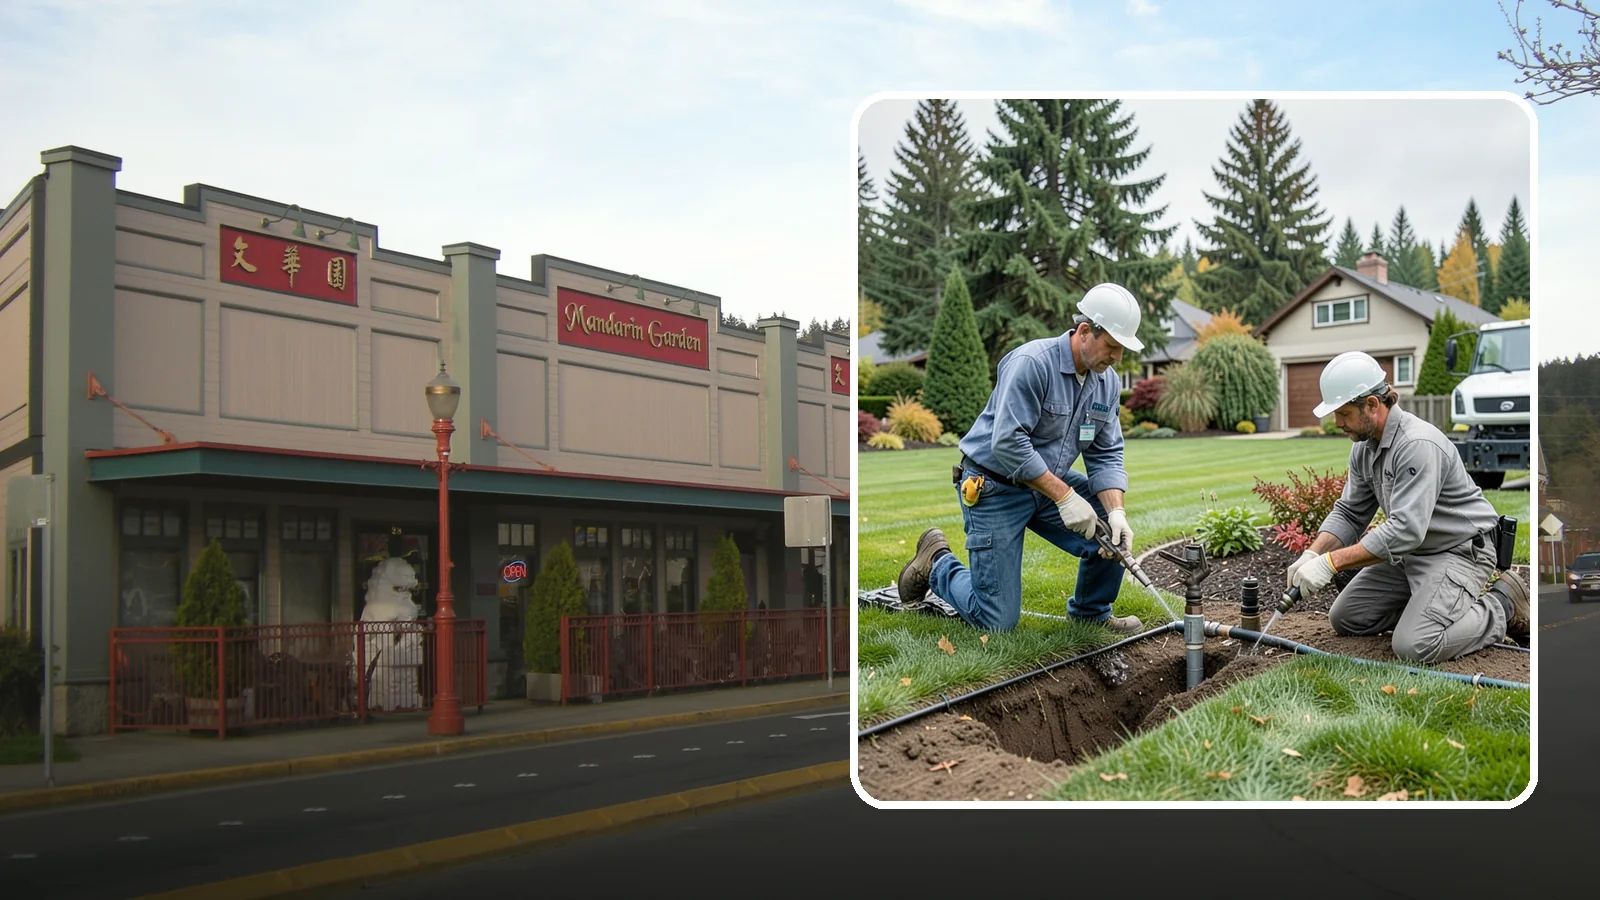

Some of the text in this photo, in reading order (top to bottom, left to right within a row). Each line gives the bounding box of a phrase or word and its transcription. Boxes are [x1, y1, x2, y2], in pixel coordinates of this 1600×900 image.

[231, 235, 346, 291] 文華園
[564, 302, 702, 352] Mandarin Garden
[503, 565, 527, 578] OPEN
